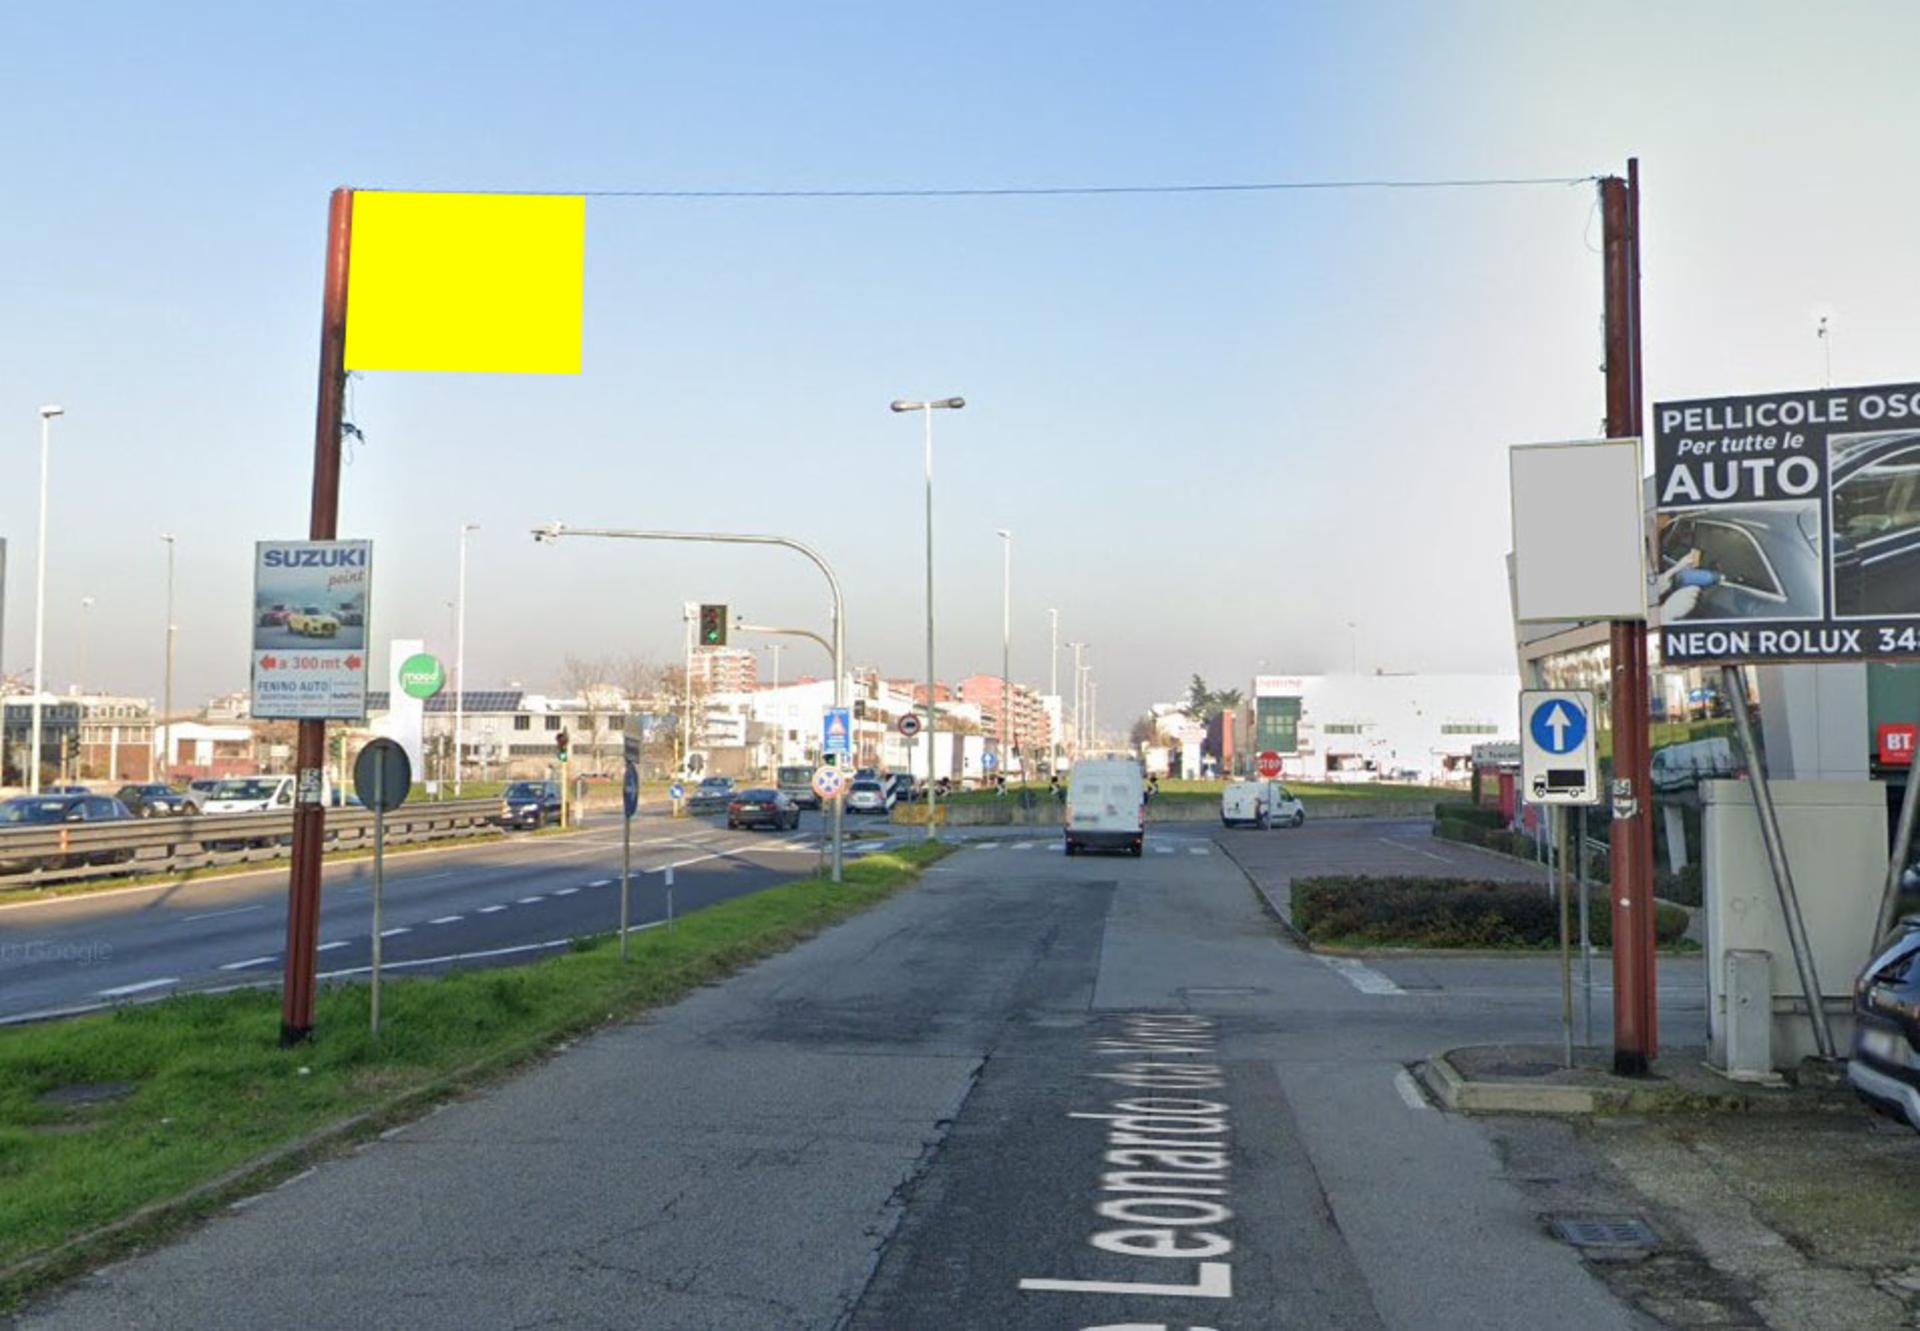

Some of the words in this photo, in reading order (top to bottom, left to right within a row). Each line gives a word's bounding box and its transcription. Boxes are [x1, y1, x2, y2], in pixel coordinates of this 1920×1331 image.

[1662, 398, 1848, 434] PELLICOLE
[1677, 439, 1713, 456] Per
[1720, 435, 1776, 453] tutte
[1783, 431, 1805, 449] le
[1662, 456, 1820, 502] AUTO
[264, 548, 366, 568] SUZUKI
[327, 570, 365, 592] point
[1667, 633, 1750, 655] NEON
[1760, 629, 1861, 653] ROLUX
[291, 656, 318, 670] 300
[321, 656, 341, 670] mt
[300, 680, 329, 692] AUTO
[1256, 759, 1282, 769] STOP
